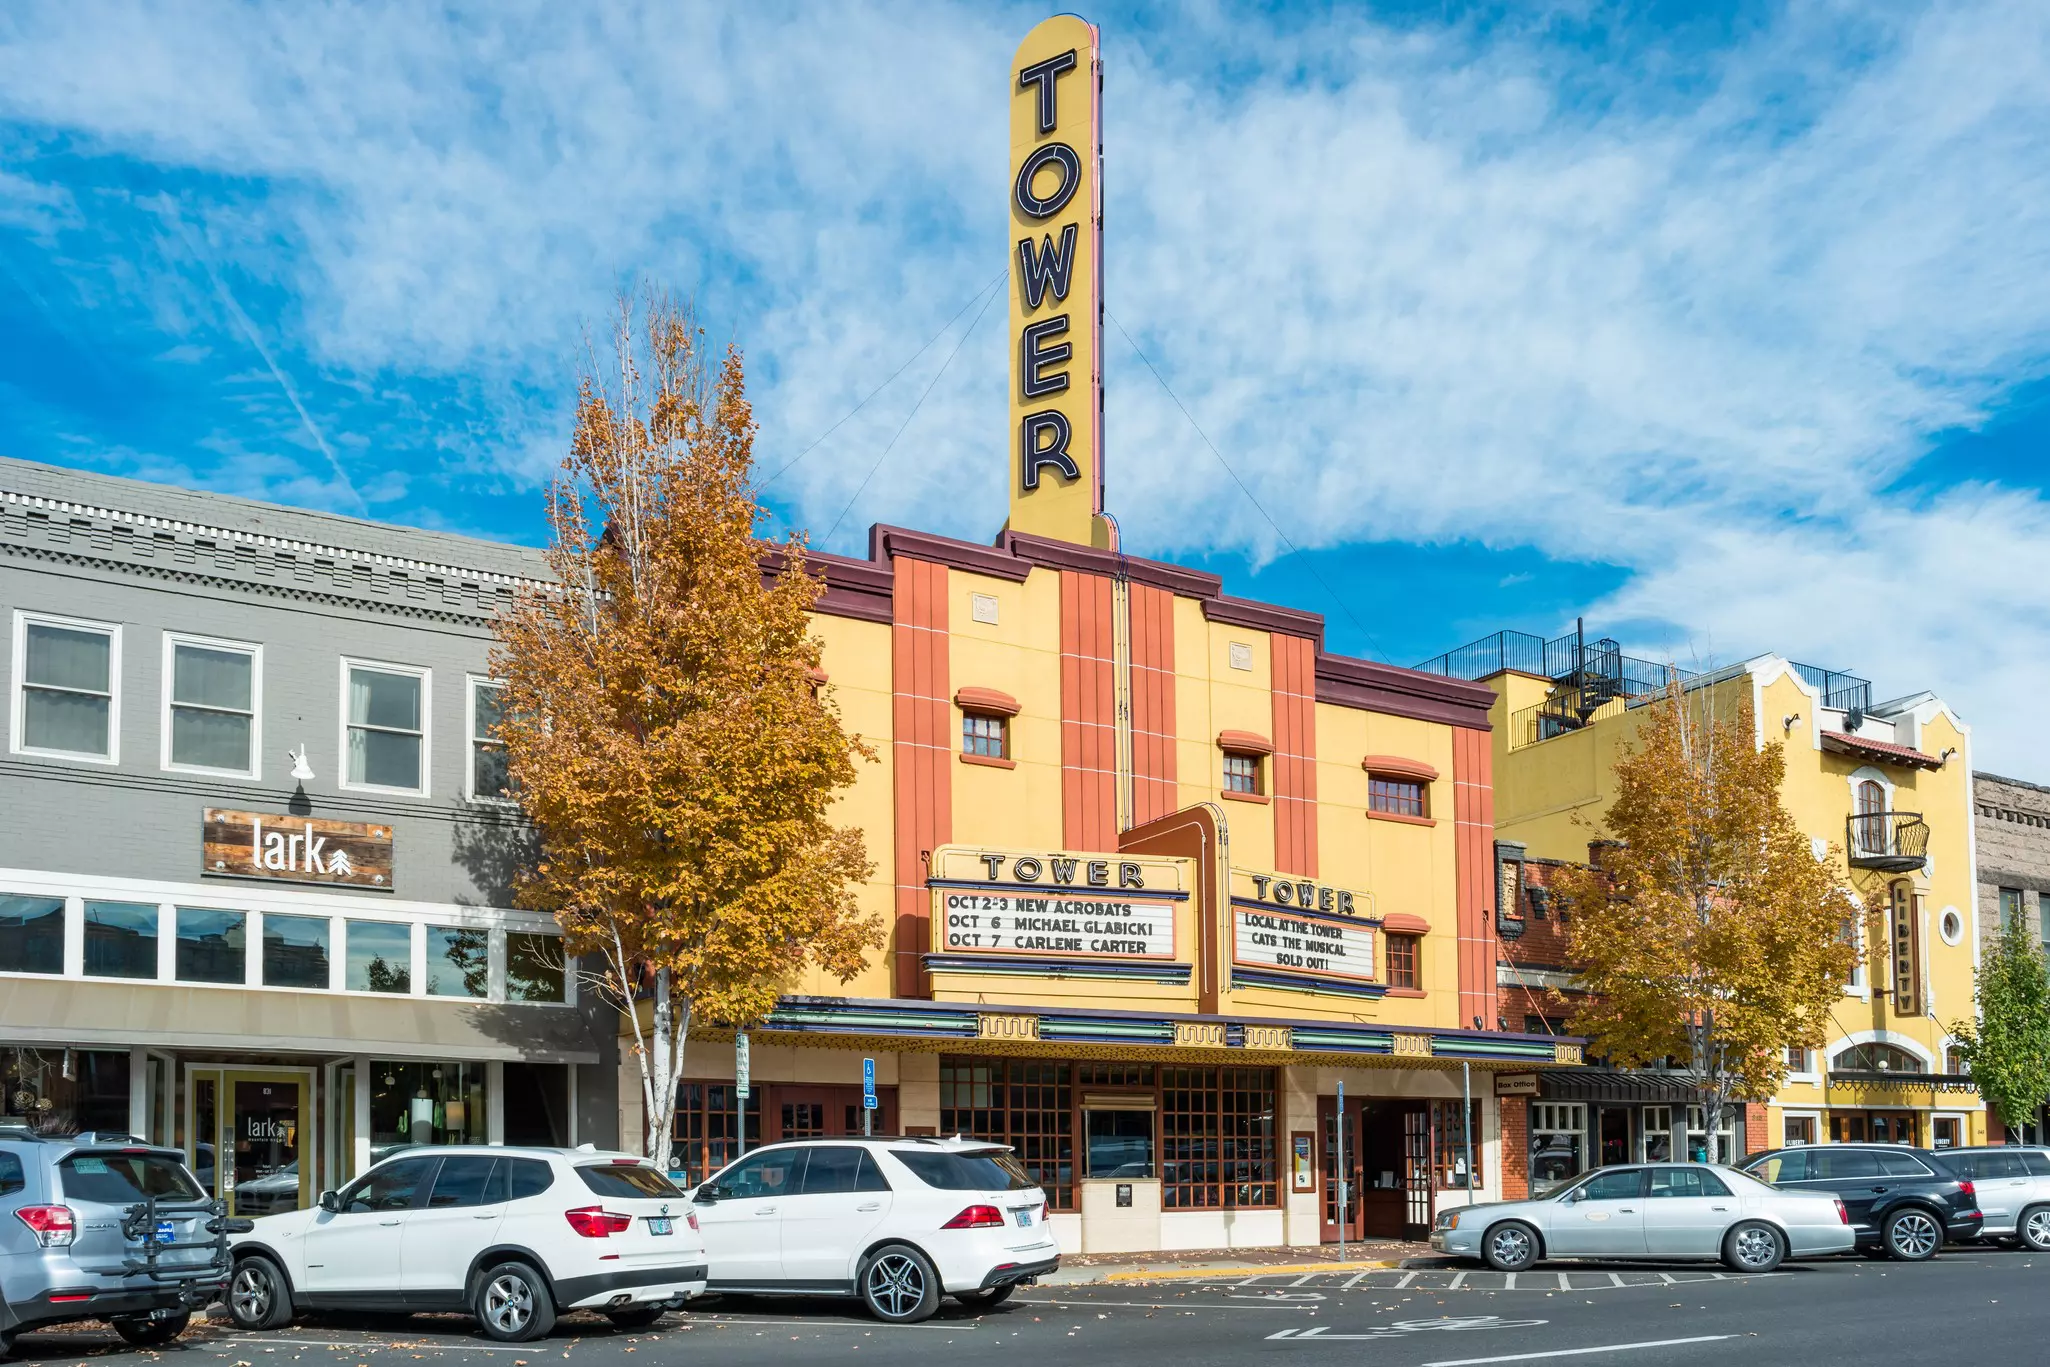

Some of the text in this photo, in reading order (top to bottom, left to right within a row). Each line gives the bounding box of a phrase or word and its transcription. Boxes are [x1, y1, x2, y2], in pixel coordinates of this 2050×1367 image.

[1017, 48, 1081, 490] TOWER
[253, 818, 326, 874] lark
[981, 855, 1144, 888] TOWER
[948, 895, 1131, 917] OCT 2-3 NEW ACROBATS
[1252, 875, 1355, 915] TOWER
[949, 915, 1152, 936] OCT 6 MICHAEL GLABICKI
[1245, 913, 1342, 940] LOCAL AT THE TOWER
[949, 933, 1147, 954] OCT 7 CARLENE CARTER
[1252, 932, 1346, 957] CATS THE MUSICAL
[1897, 888, 1911, 1010] LIBERTY
[1276, 952, 1329, 970] SOLD OUT!
[248, 1116, 276, 1137] lark
